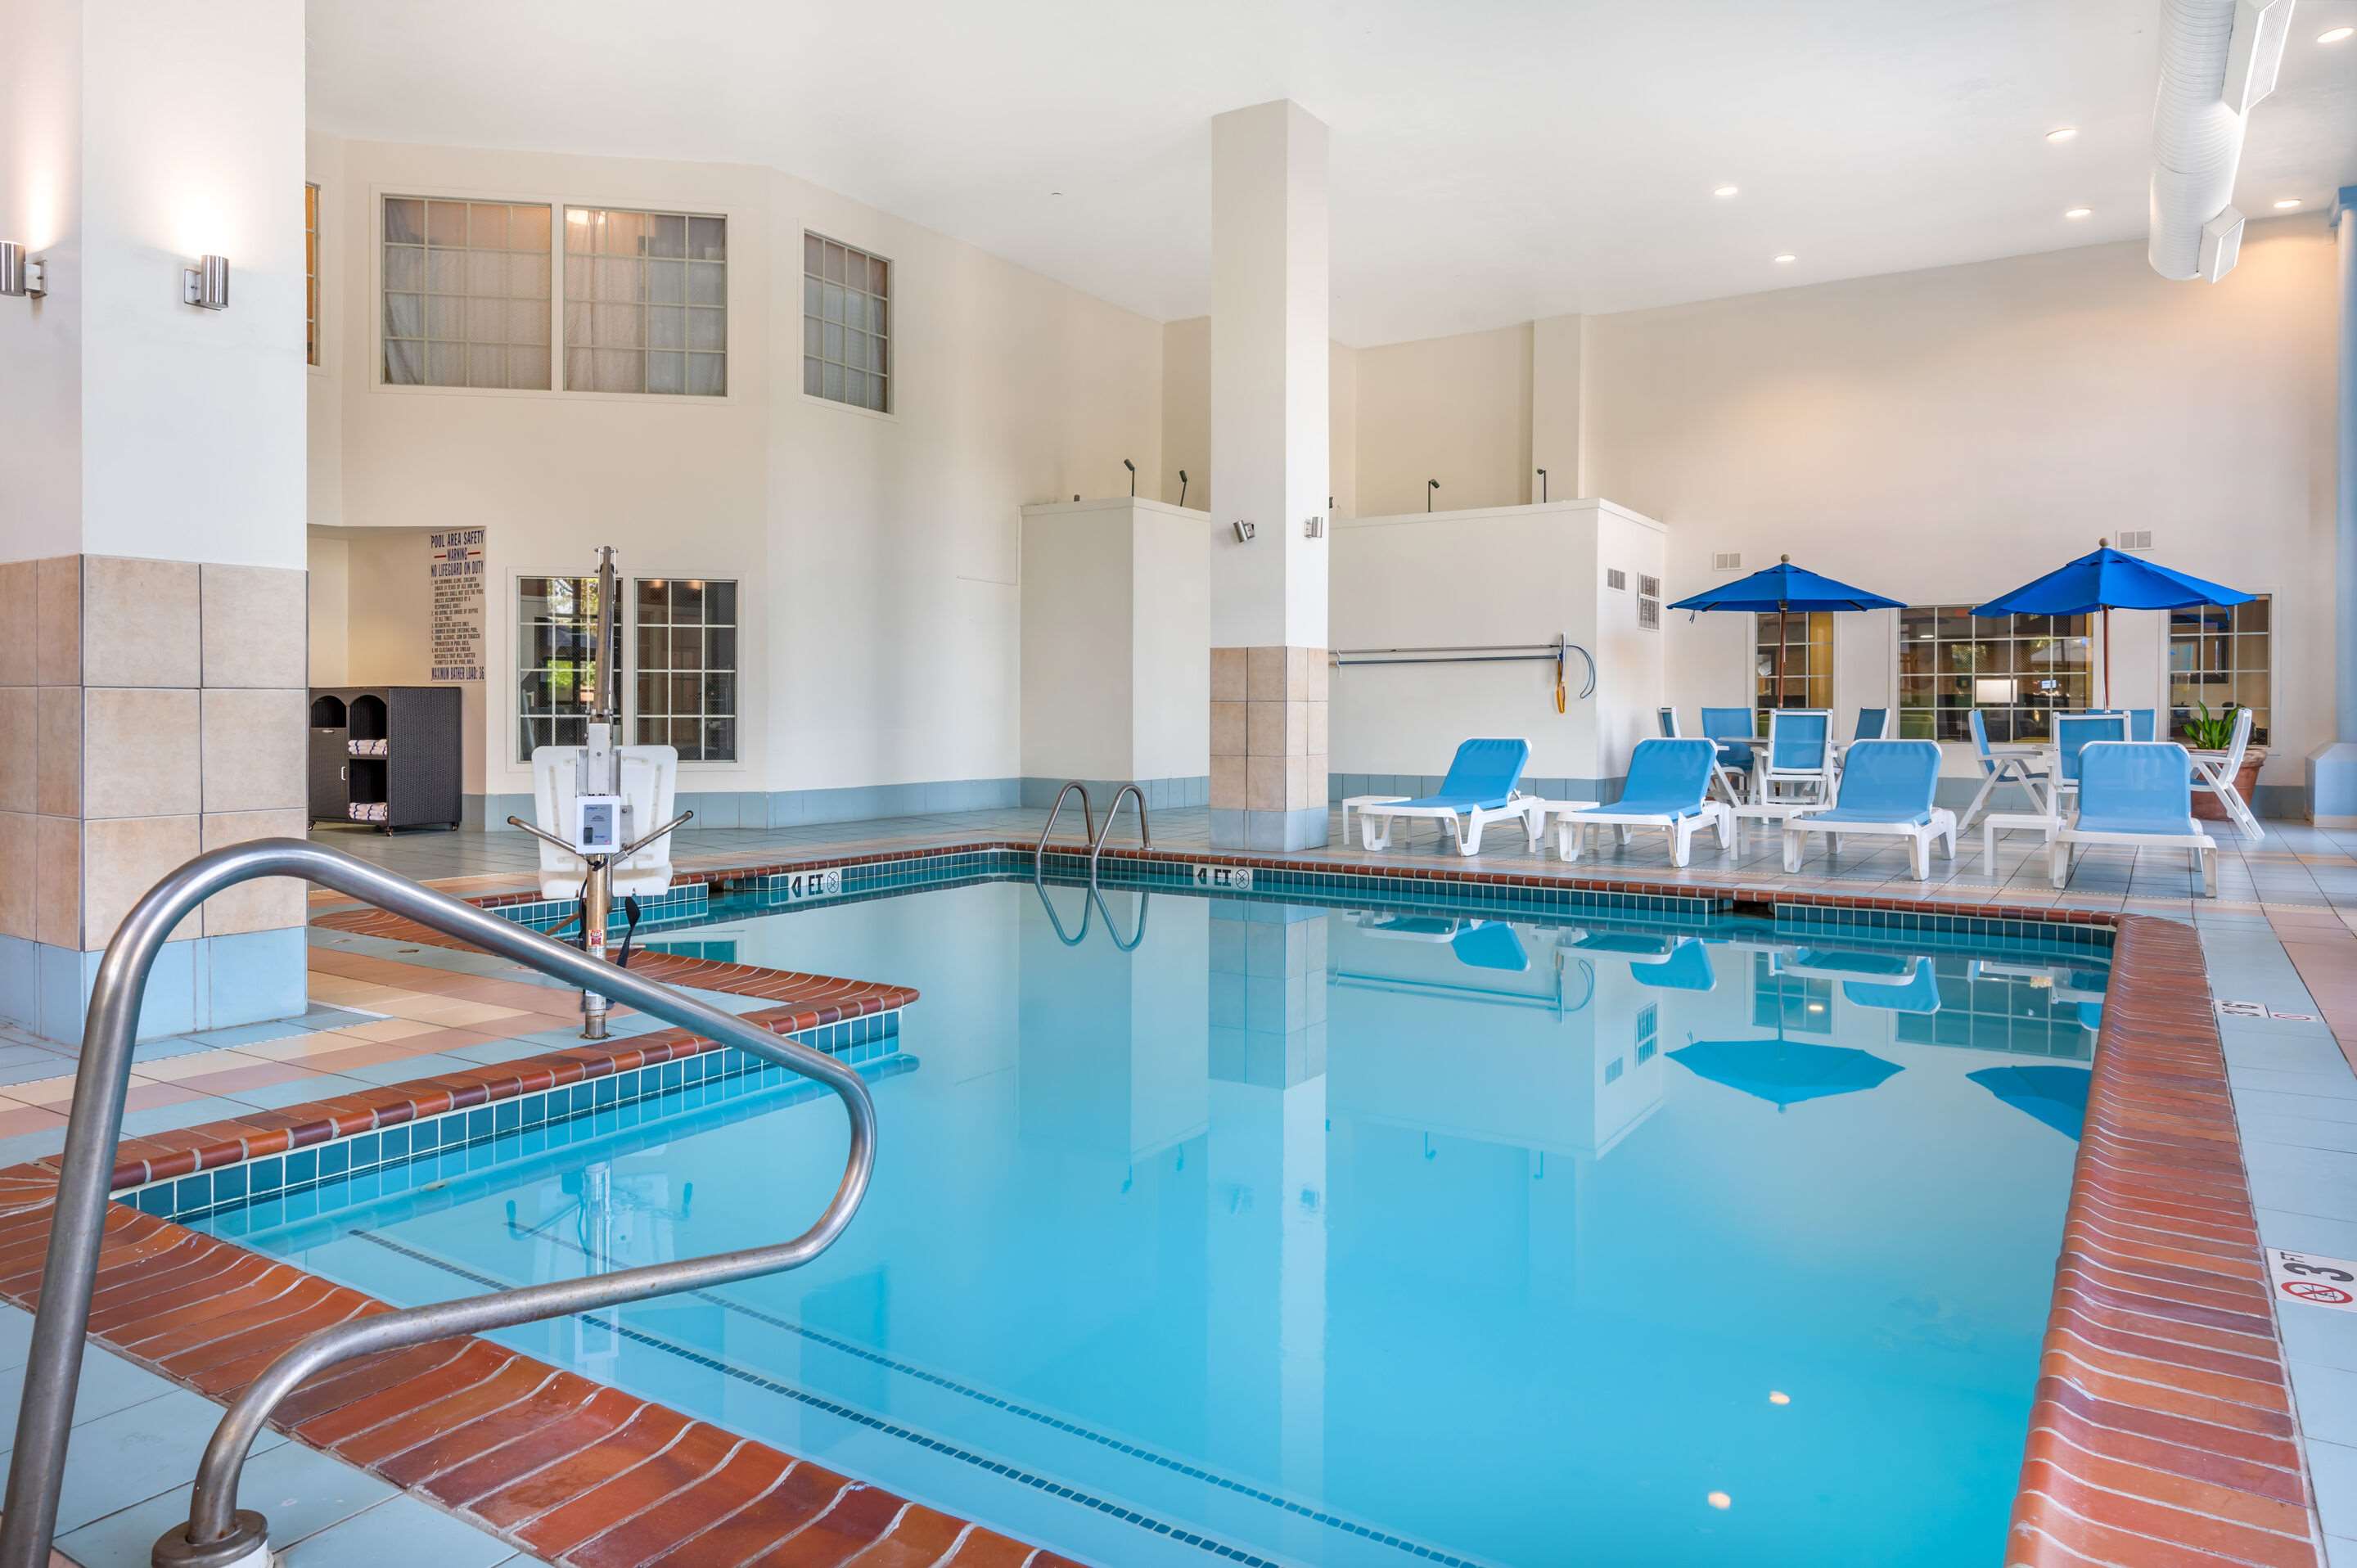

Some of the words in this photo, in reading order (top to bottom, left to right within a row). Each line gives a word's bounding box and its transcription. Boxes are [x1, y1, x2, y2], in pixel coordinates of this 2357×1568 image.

[430, 534, 445, 548] POOL
[447, 532, 462, 547] AREA
[463, 530, 484, 545] SAFETY
[448, 547, 467, 561] WARNING
[431, 564, 437, 577] NO
[439, 562, 462, 577] LIFEGUARD
[464, 561, 470, 574] ON
[472, 561, 484, 574] DUTY
[431, 667, 449, 681] MAXIMUM
[450, 667, 465, 680] BATHER
[466, 666, 477, 680] LOAD:
[479, 666, 484, 680] 36
[2280, 1251, 2305, 1263] FT
[2283, 1263, 2355, 1282] 3
